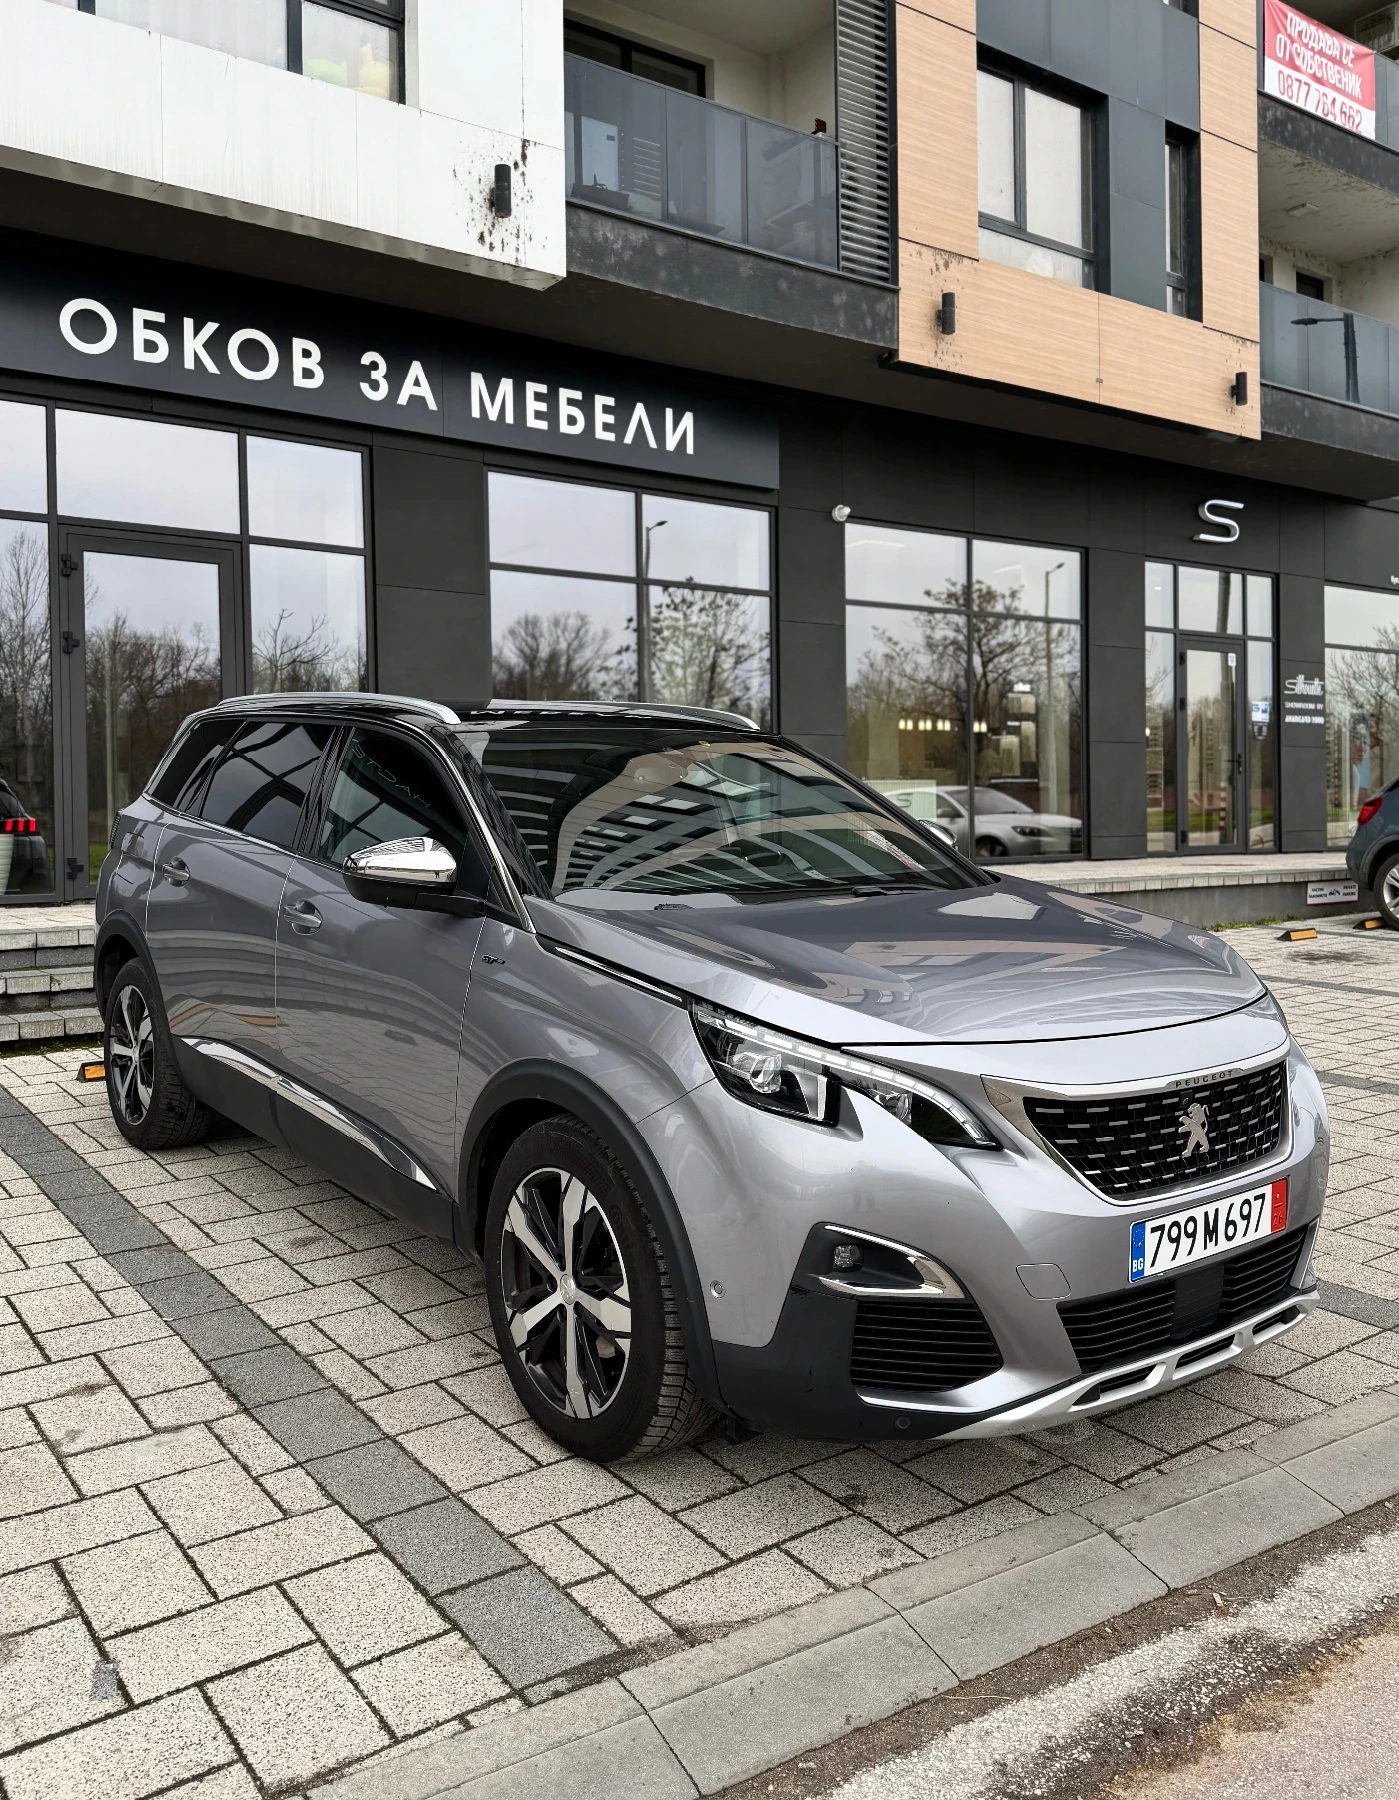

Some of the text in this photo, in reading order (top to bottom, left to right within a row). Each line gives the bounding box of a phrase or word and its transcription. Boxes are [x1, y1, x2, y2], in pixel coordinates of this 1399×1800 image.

[1276, 33, 1363, 100] ОТ СОБСТВЕНИК
[1286, 11, 1356, 69] ПРОДАВА СЕ
[1277, 70, 1363, 134] 0877 764 662
[59, 298, 696, 455] ОБКОВ ЗА МЕБЕЛИ
[1195, 499, 1244, 542] S
[1175, 1070, 1234, 1089] PEUGEOT
[1132, 1257, 1144, 1273] BG
